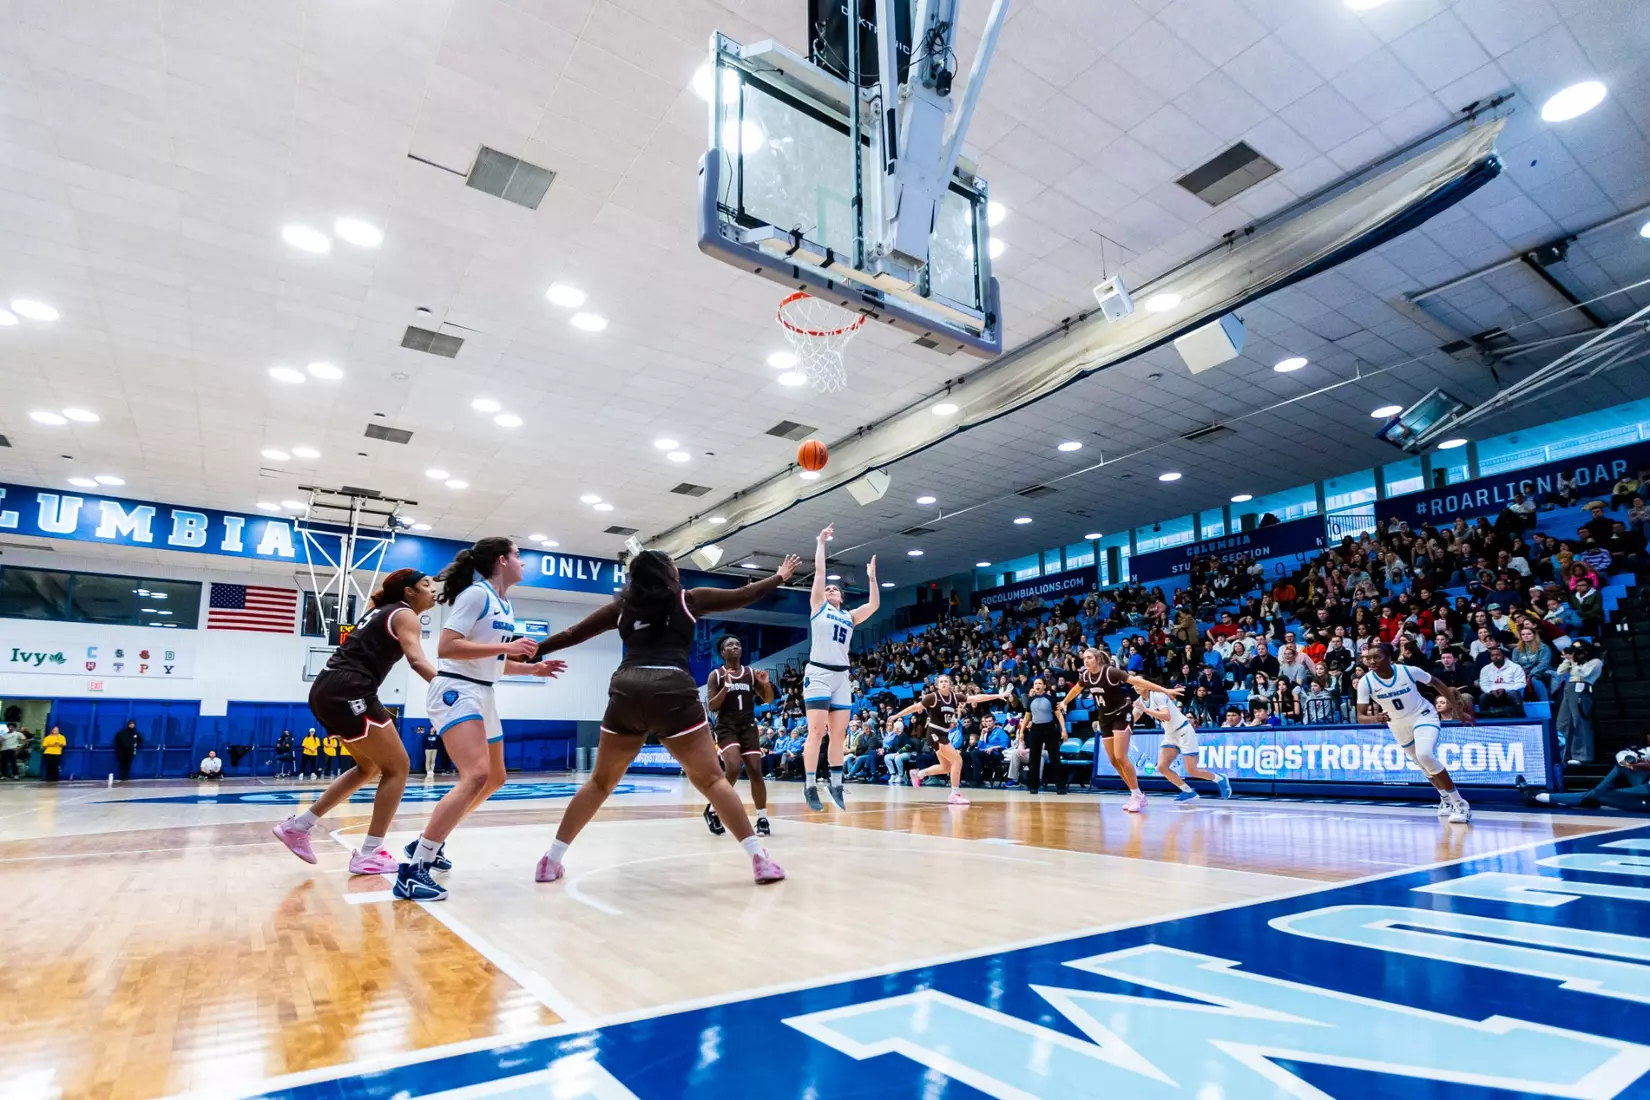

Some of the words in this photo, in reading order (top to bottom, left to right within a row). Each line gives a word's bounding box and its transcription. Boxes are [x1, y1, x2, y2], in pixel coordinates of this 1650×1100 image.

[541, 554, 602, 581] ONLY
[981, 576, 1084, 605] GOCOLUMBIALIONS.COM
[832, 623, 848, 645] 15
[10, 648, 48, 667] Ivy
[728, 683, 751, 692] ROWN
[348, 698, 368, 716] B
[737, 694, 743, 711] 1
[1391, 698, 1405, 710] 0
[1197, 743, 1526, 775] INFO@STROKOCOM
